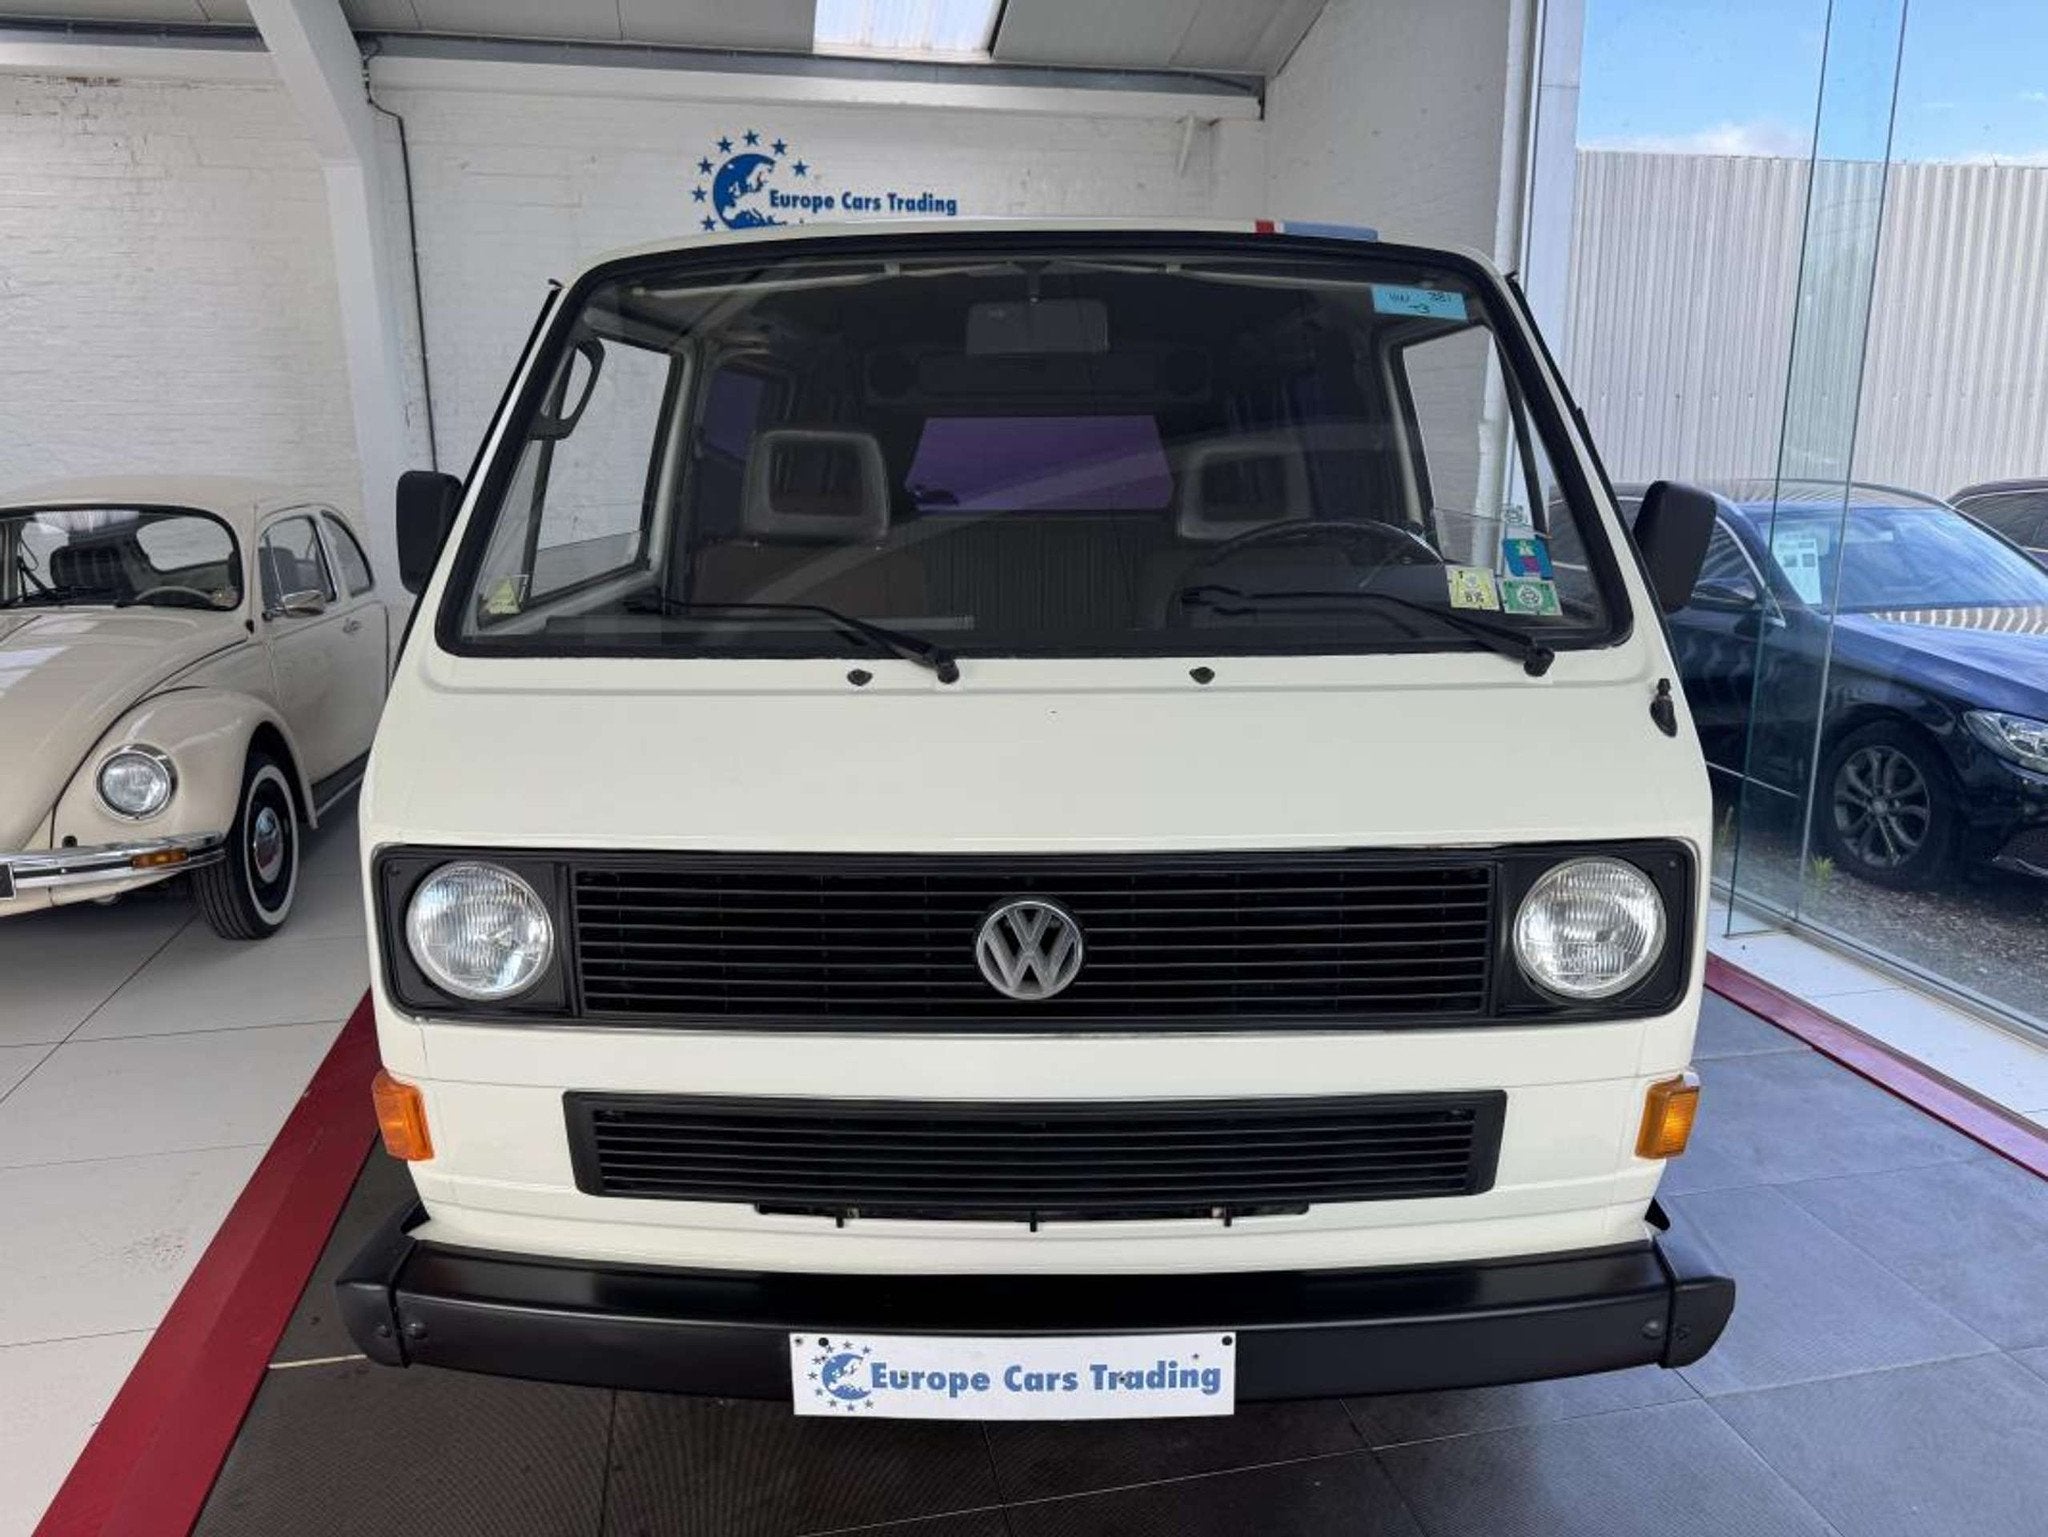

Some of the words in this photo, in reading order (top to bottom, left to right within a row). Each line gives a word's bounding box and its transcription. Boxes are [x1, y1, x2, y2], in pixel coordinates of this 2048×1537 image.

[768, 189, 835, 213] Europe
[841, 192, 882, 212] Cars
[888, 192, 957, 216] Trading
[976, 900, 1083, 1000] VW
[870, 1362, 991, 1398] Europe
[1004, 1365, 1078, 1393] Cars
[1090, 1360, 1221, 1395] Trading
